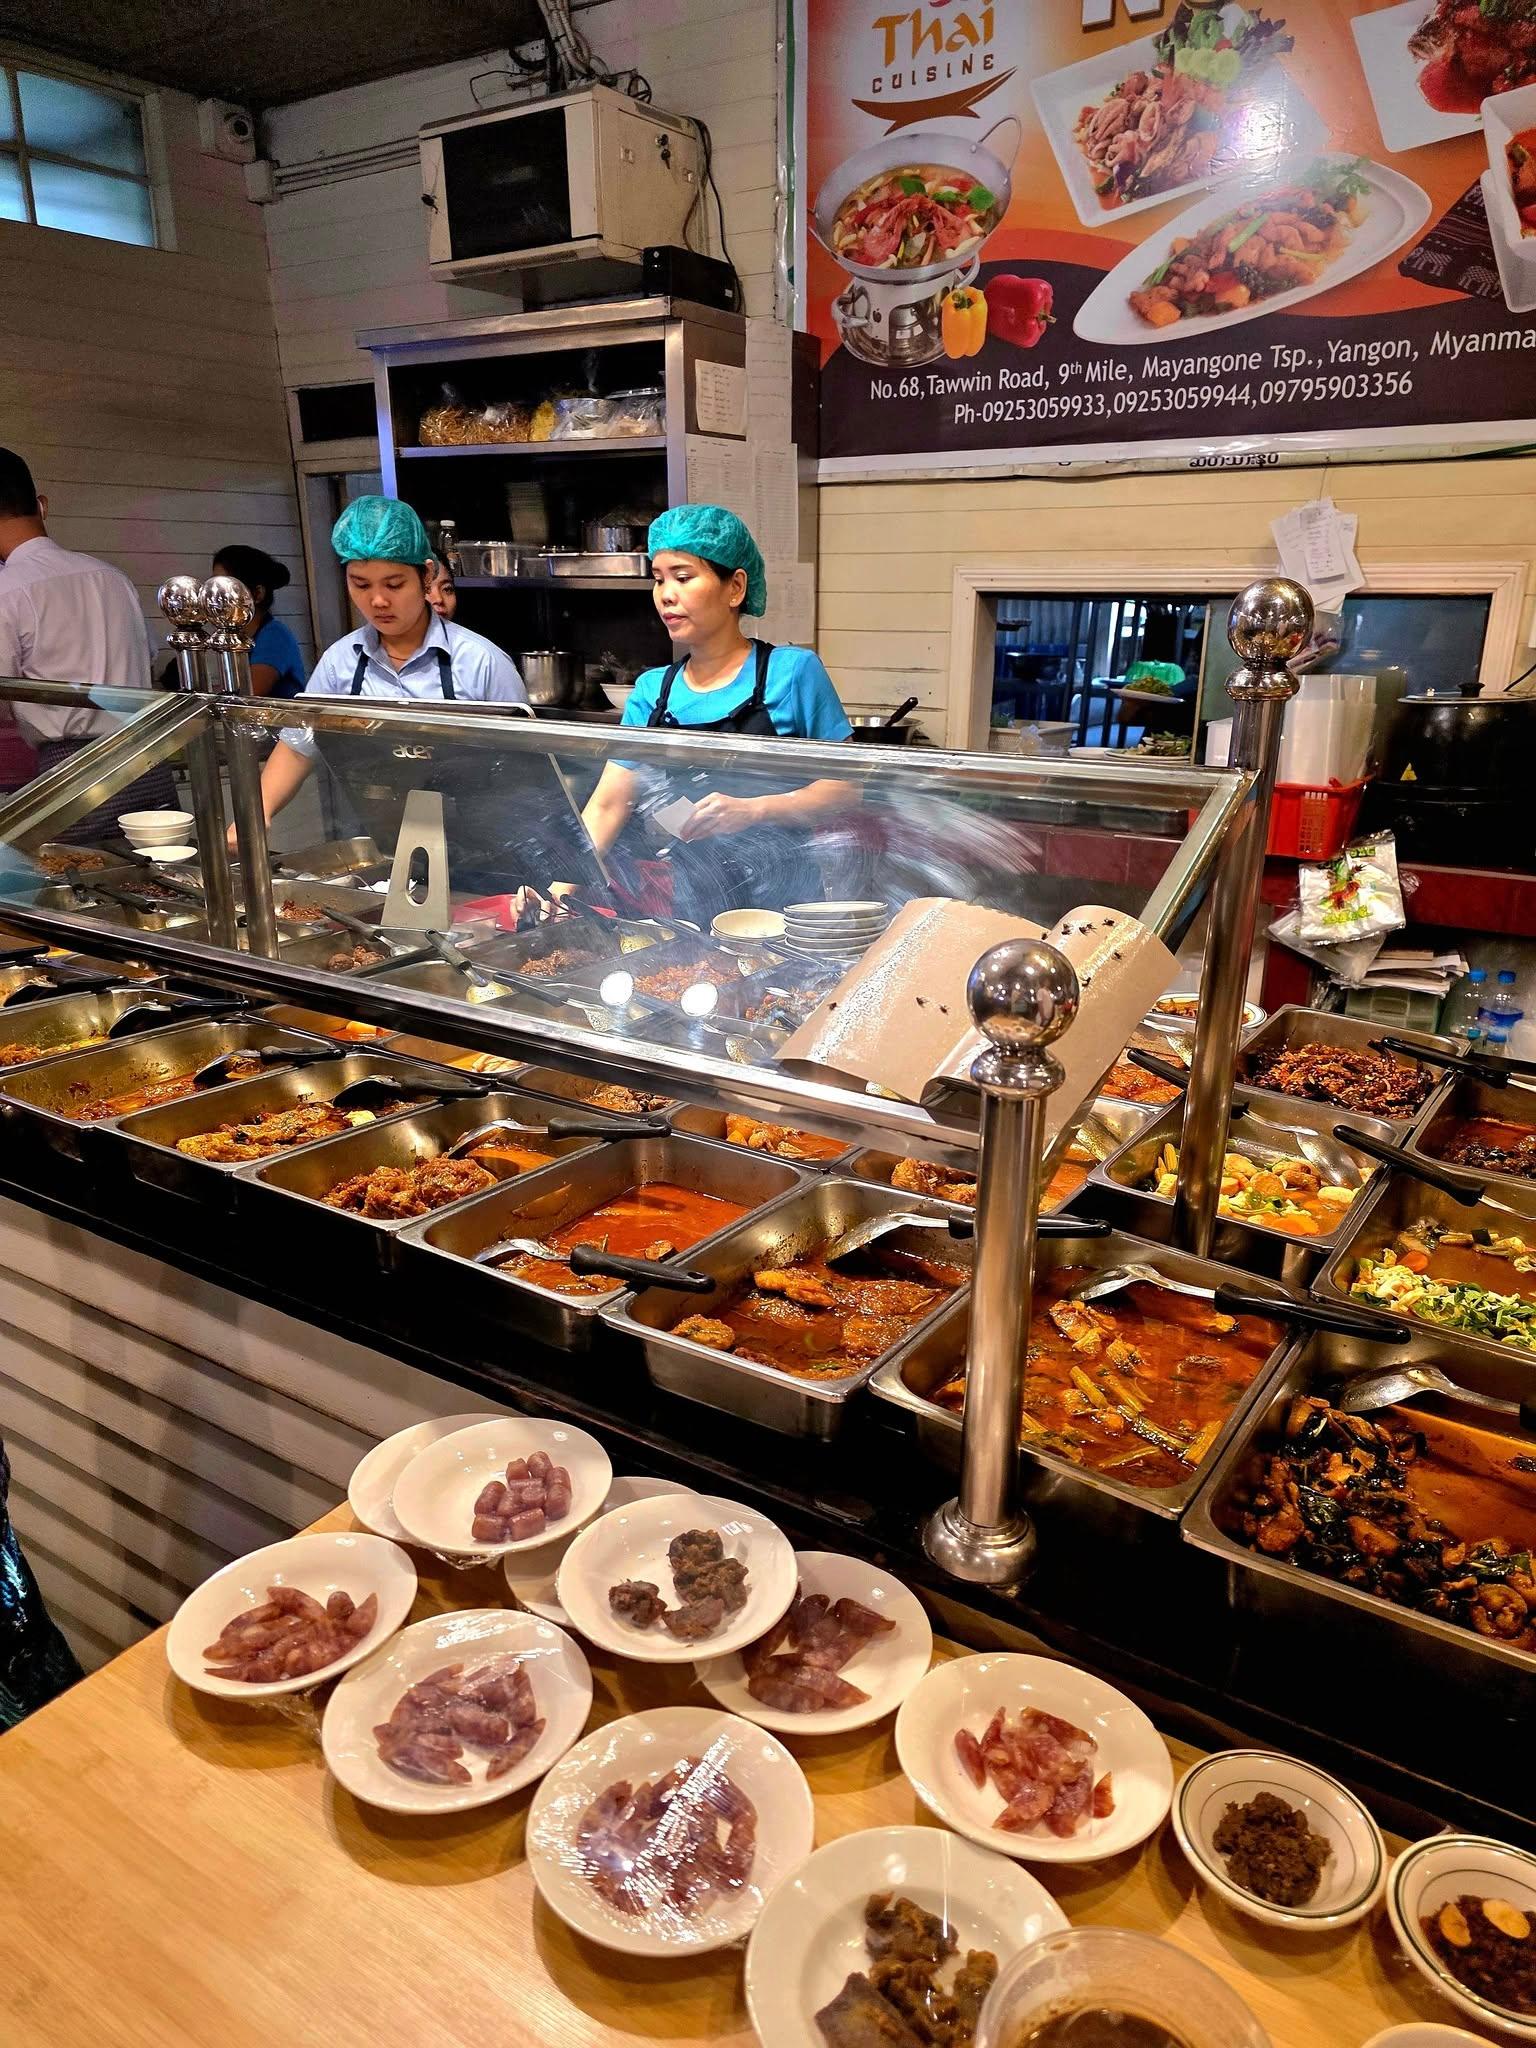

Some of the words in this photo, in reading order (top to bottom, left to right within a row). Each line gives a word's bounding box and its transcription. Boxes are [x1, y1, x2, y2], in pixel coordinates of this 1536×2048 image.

[872, 1, 995, 68] Thai
[871, 53, 995, 94] CUISINE
[999, 365, 1050, 390] Road,
[1142, 352, 1263, 382] Mayangone
[392, 744, 434, 759] acer
